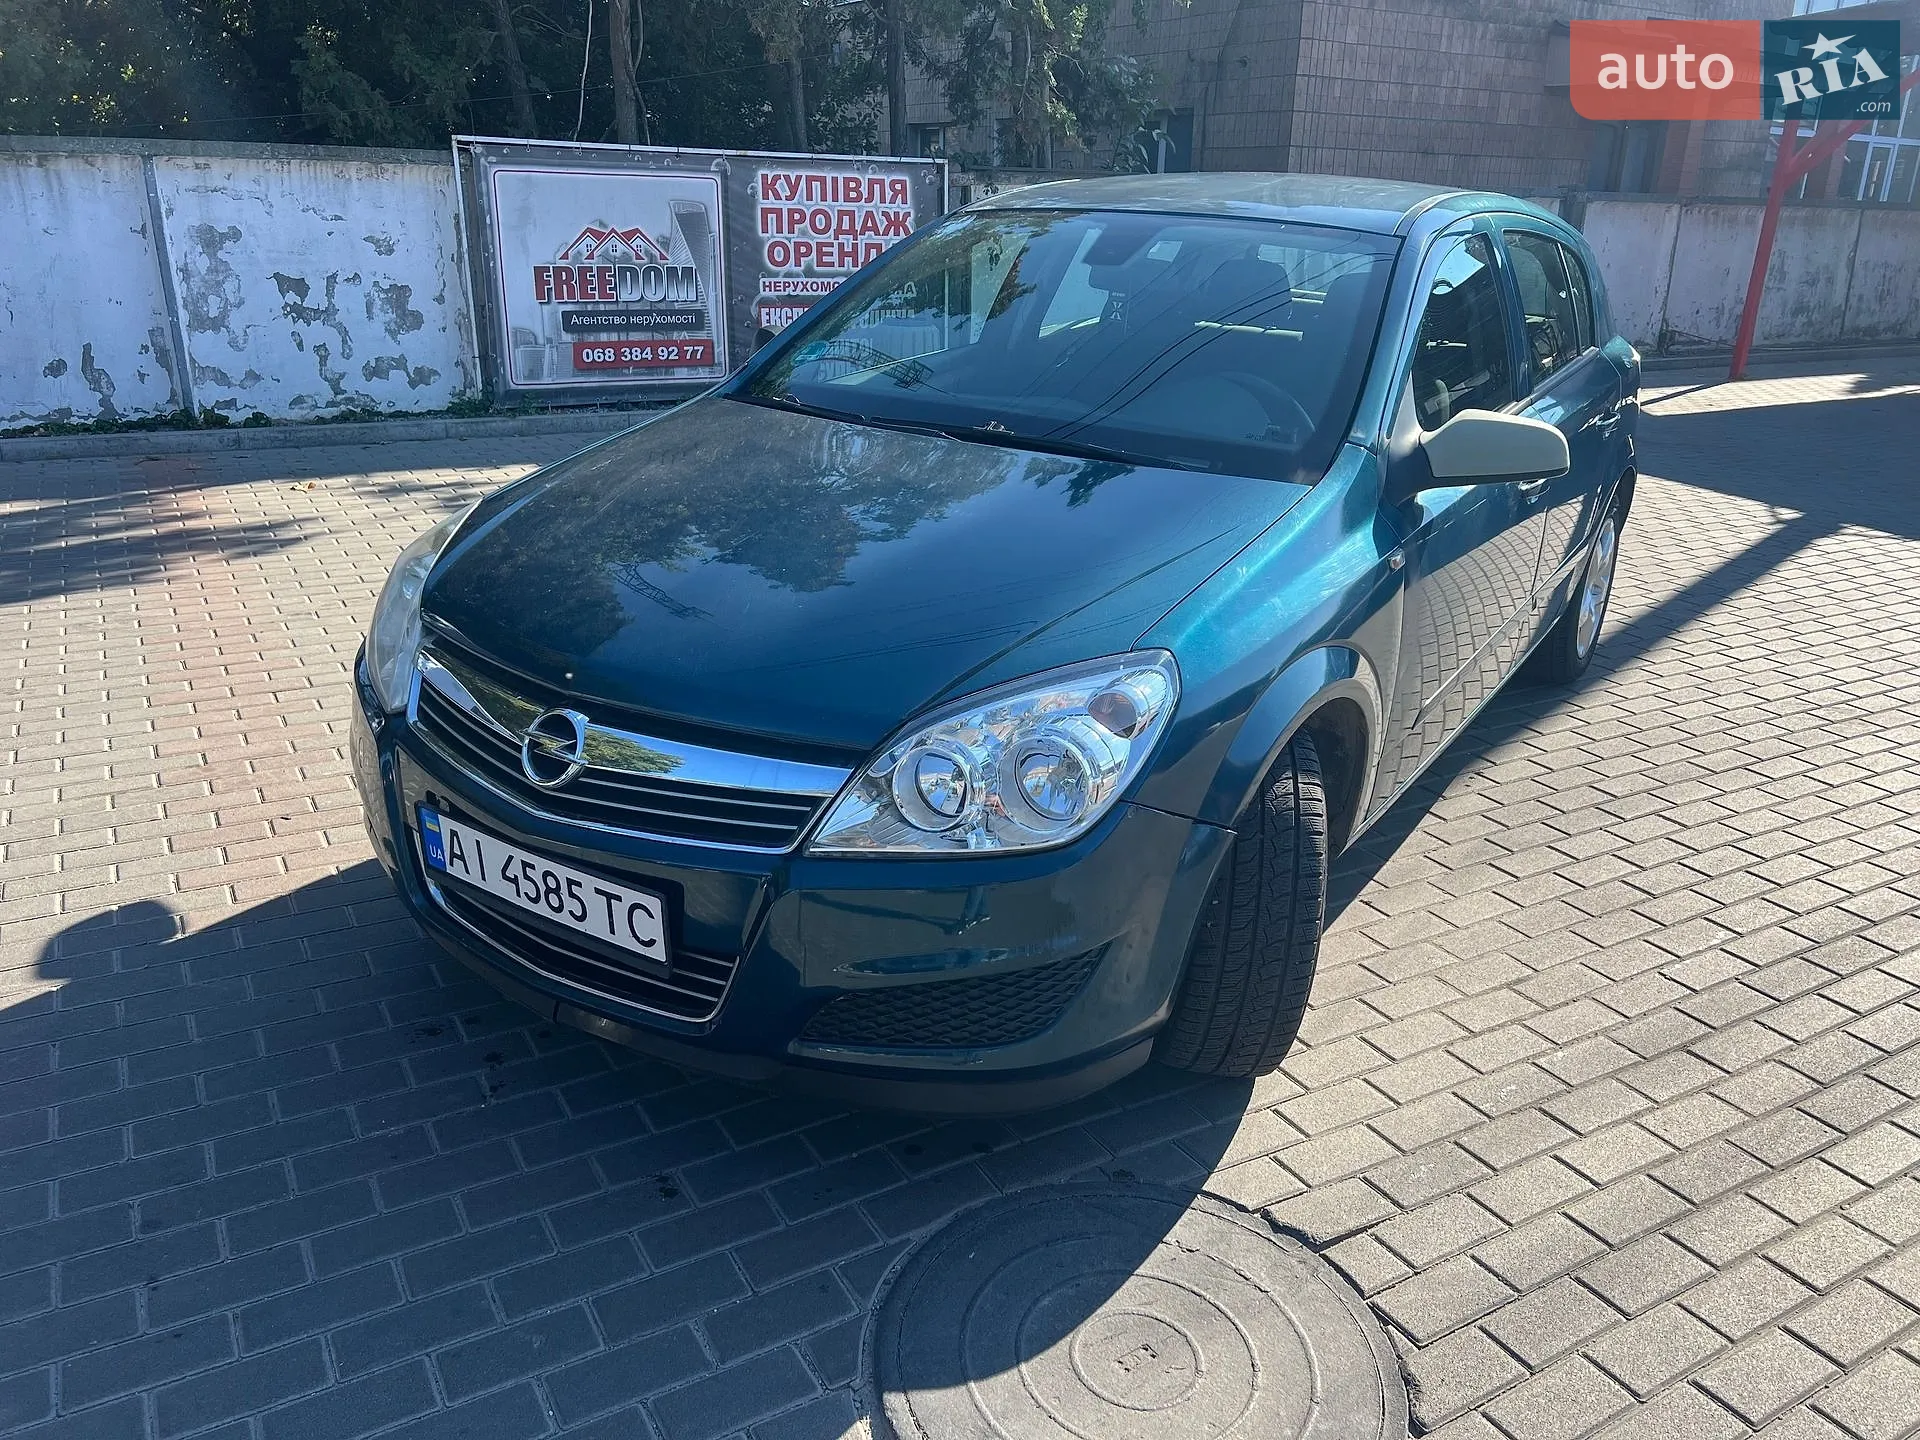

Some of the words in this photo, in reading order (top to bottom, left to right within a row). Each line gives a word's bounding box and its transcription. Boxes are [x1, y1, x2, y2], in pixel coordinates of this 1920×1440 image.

[760, 173, 908, 205] КУПІВЛЯ
[760, 207, 912, 241] ПРОДАЖ
[767, 240, 888, 268] ОРЕНД
[533, 265, 698, 302] FREEDOM
[570, 313, 627, 326] Агентство
[630, 312, 696, 327] нерухомості
[582, 348, 615, 363] 068
[620, 347, 653, 362] 384
[658, 346, 679, 360] 92
[683, 345, 704, 360] 77
[429, 846, 445, 862] UA
[449, 828, 487, 882] AI
[501, 854, 588, 923] 4585
[594, 887, 657, 948] TC
